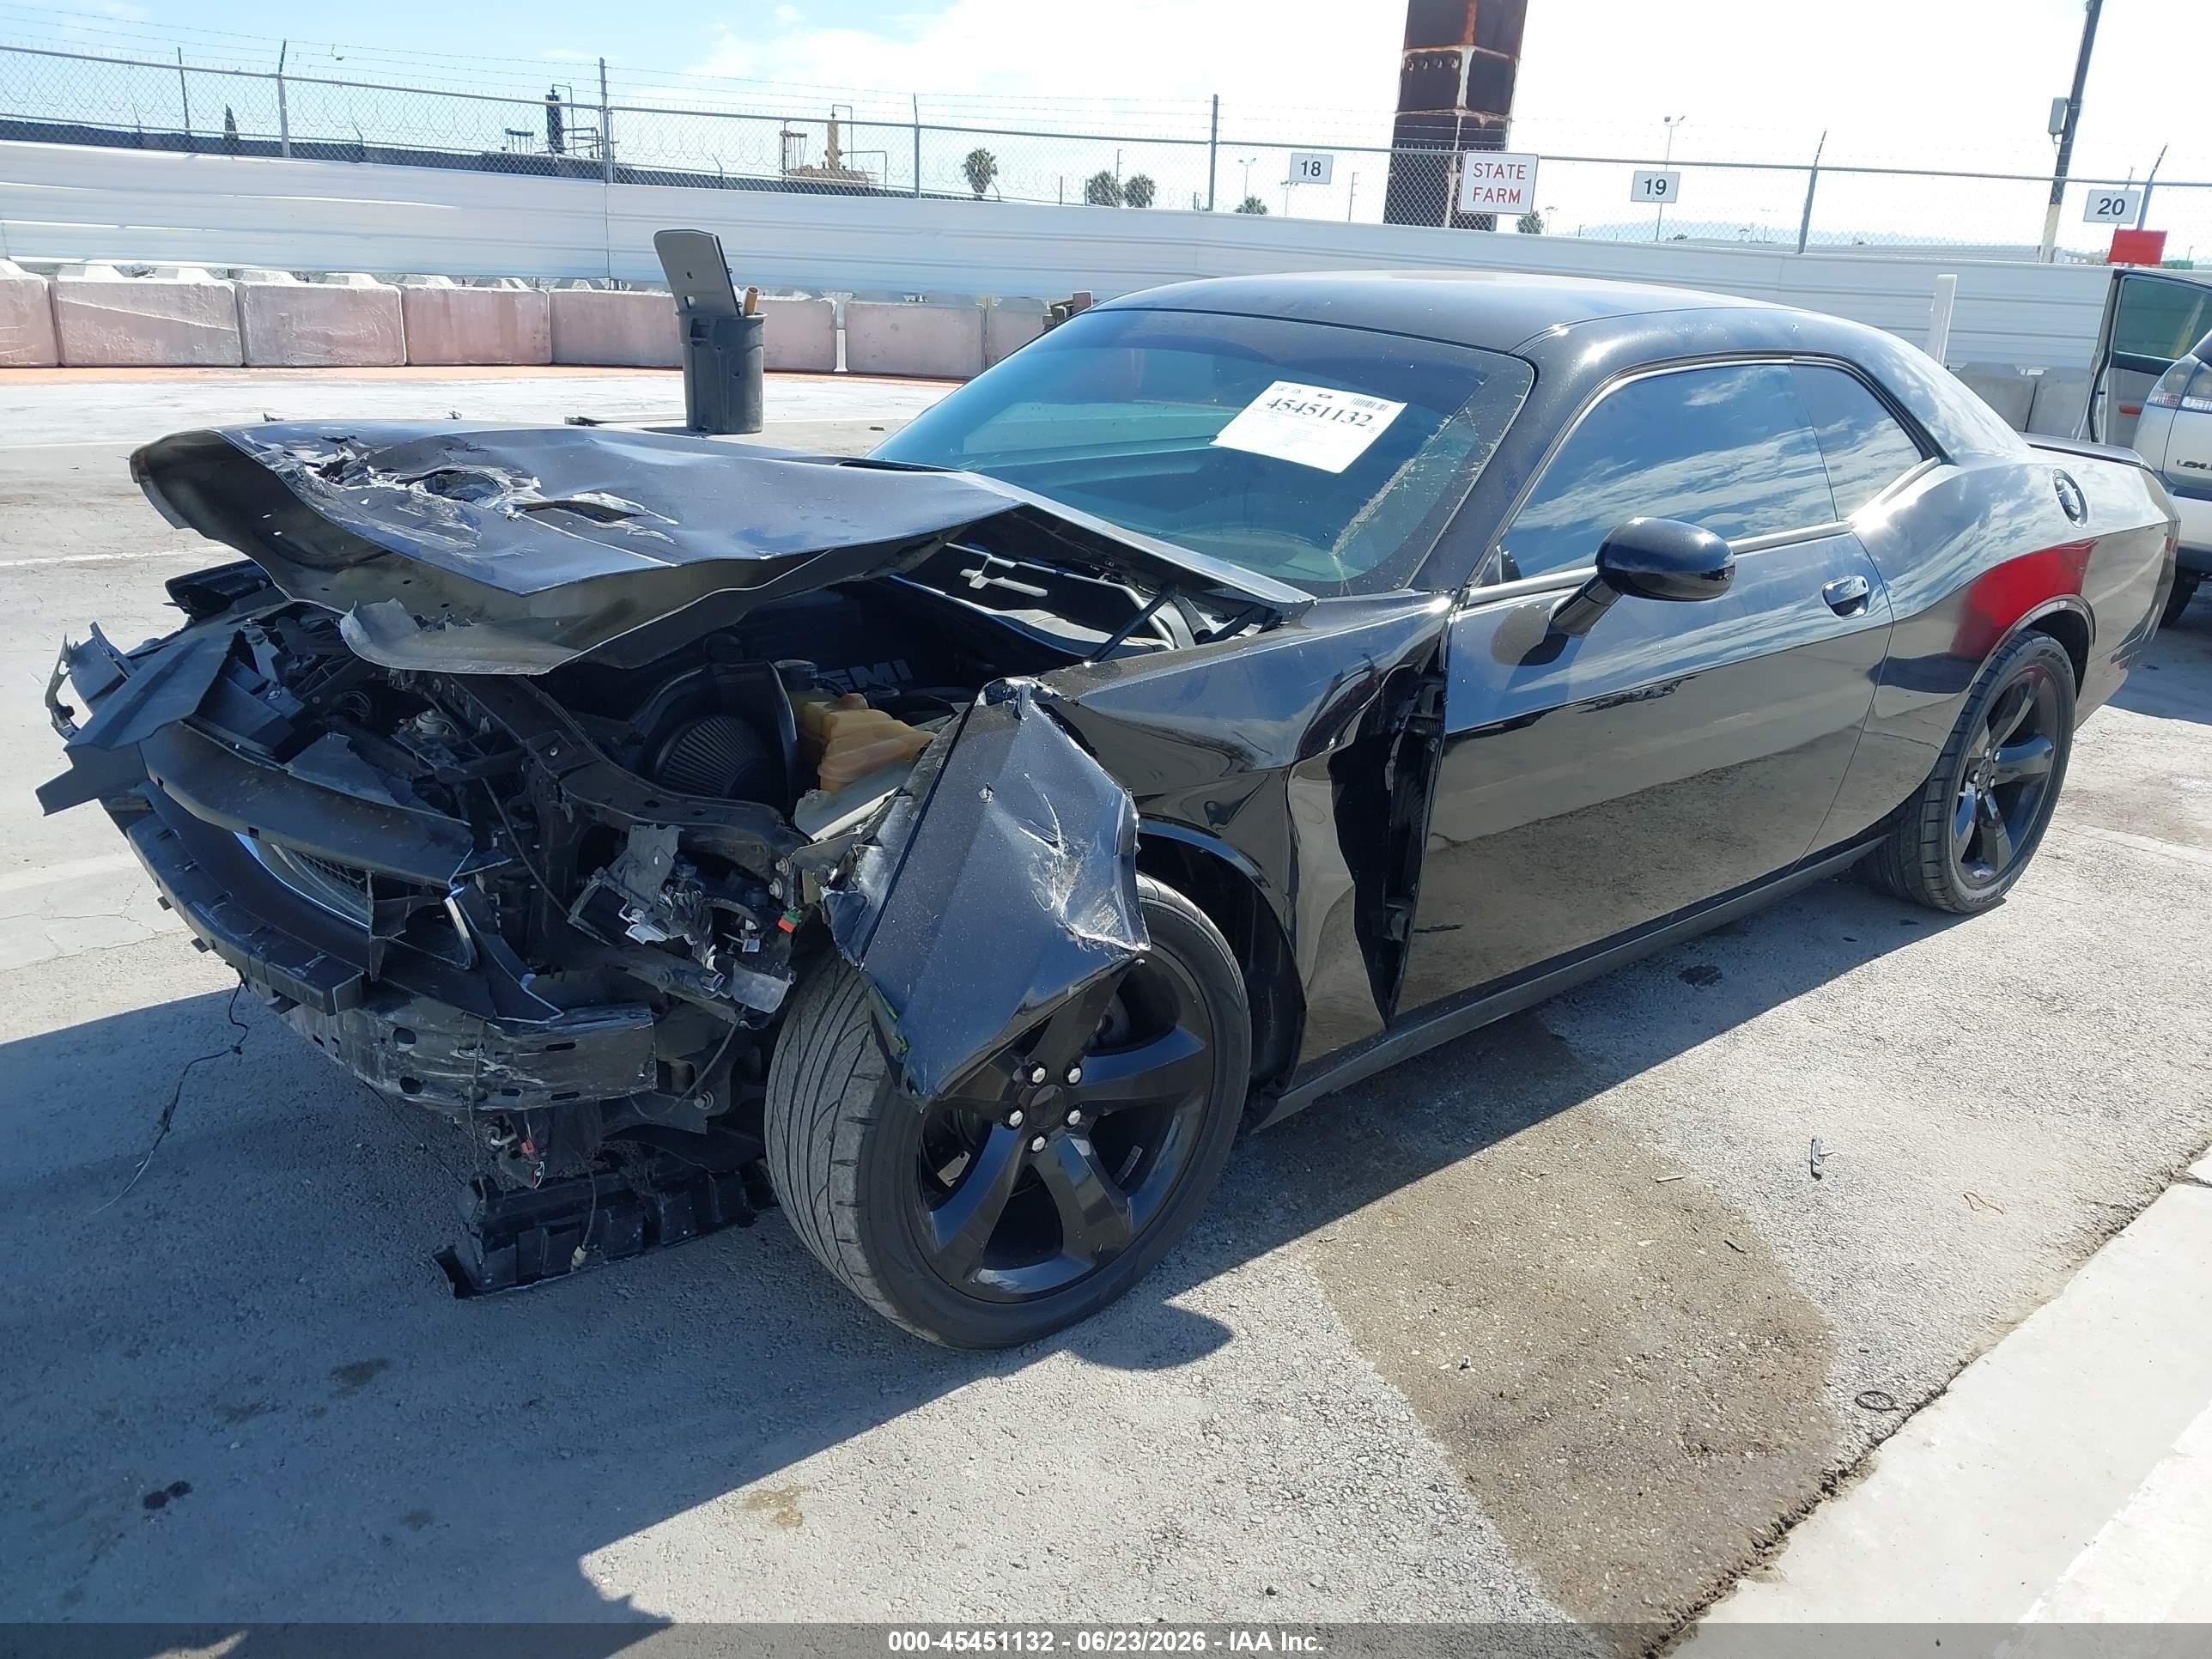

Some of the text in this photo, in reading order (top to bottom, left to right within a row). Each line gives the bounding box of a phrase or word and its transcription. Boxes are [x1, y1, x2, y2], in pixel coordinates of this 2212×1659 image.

[1300, 160, 1322, 177] 18
[1473, 161, 1528, 181] STATE
[1472, 185, 1522, 205] FARM
[1643, 178, 1668, 197] 19
[2096, 198, 2126, 216] 20
[1265, 398, 1374, 428] 45451132
[818, 659, 915, 690] EMI
